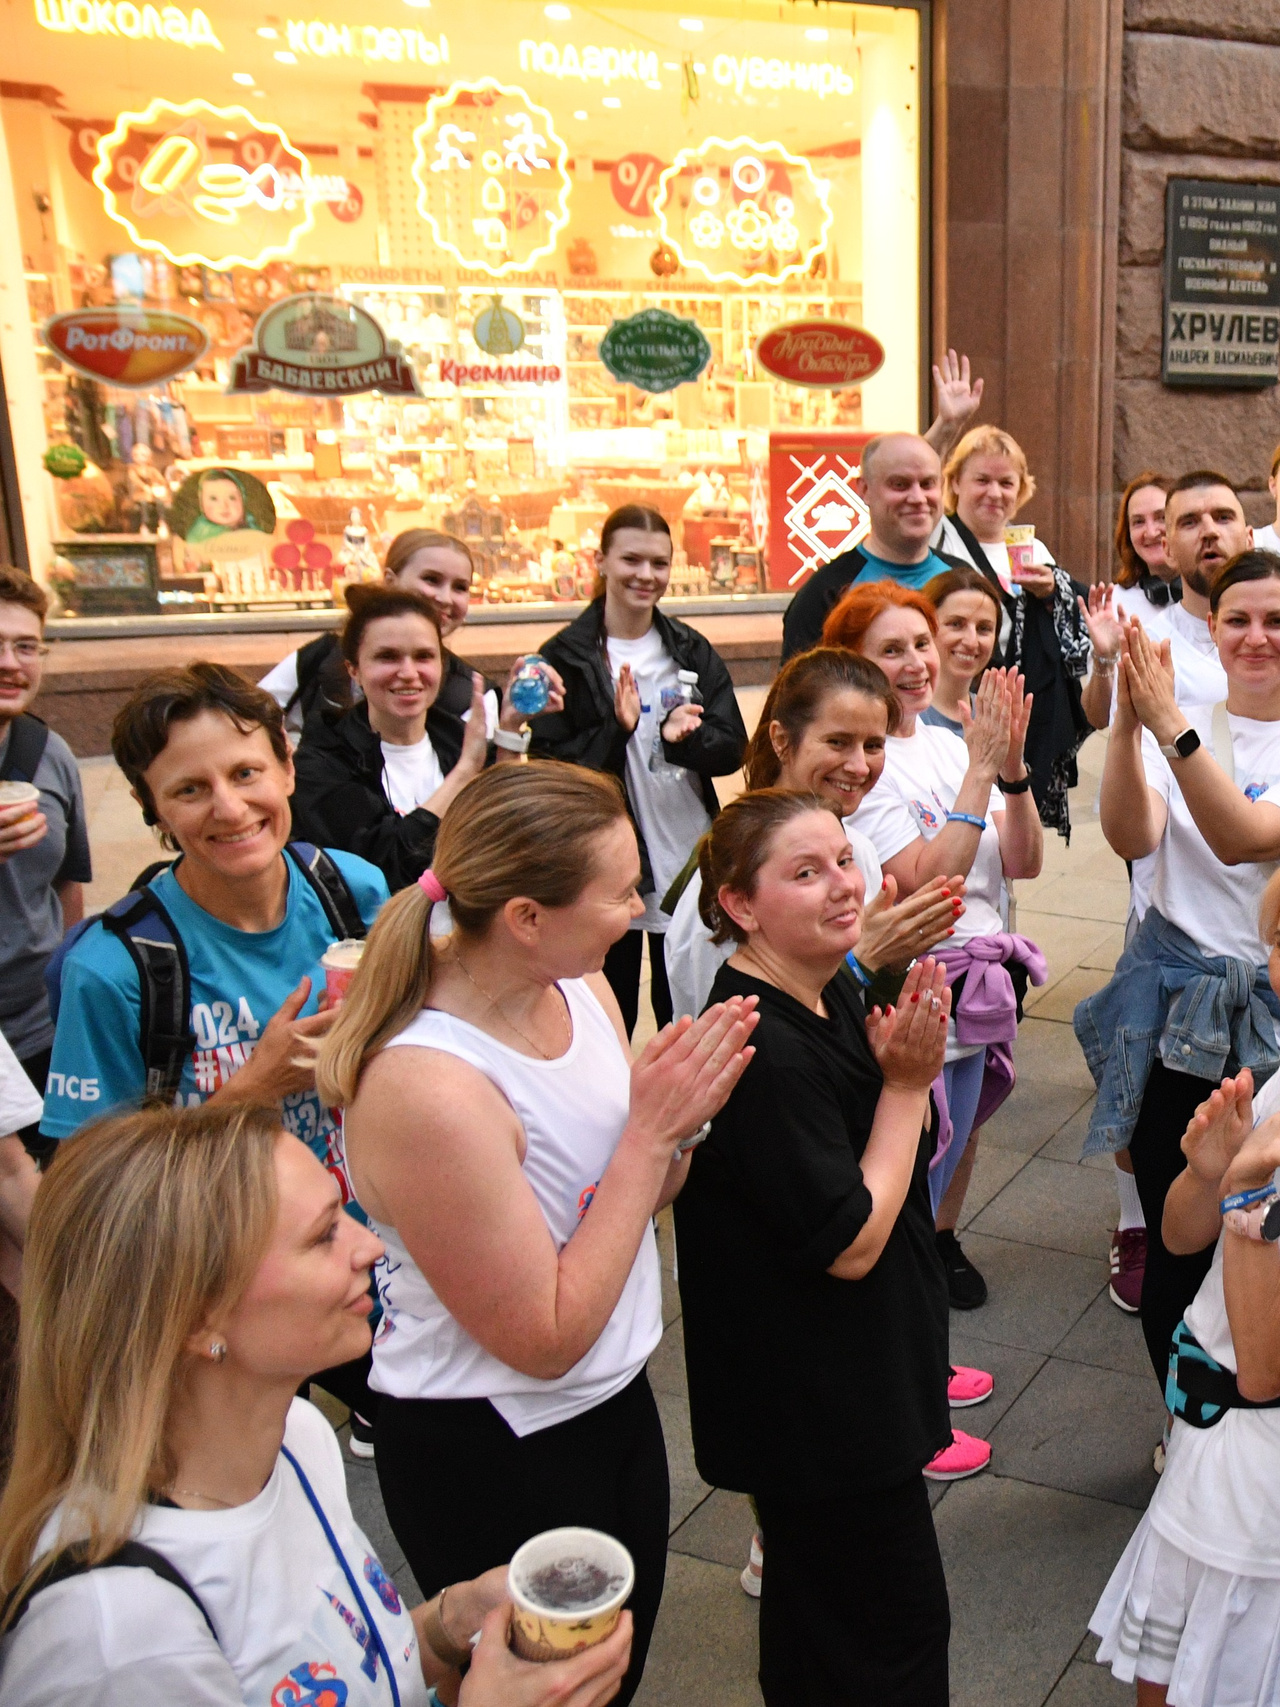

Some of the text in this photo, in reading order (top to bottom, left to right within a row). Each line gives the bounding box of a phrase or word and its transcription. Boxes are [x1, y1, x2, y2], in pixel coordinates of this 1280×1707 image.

[34, 0, 225, 52] шоколад
[519, 39, 659, 86] подарки
[1170, 311, 1279, 343] ХРУЛЕВ
[257, 359, 393, 389] БАБАЕВСКИЙ
[439, 359, 561, 387] Кремлина
[190, 996, 260, 1049] 024
[47, 1071, 101, 1101] ПСБ
